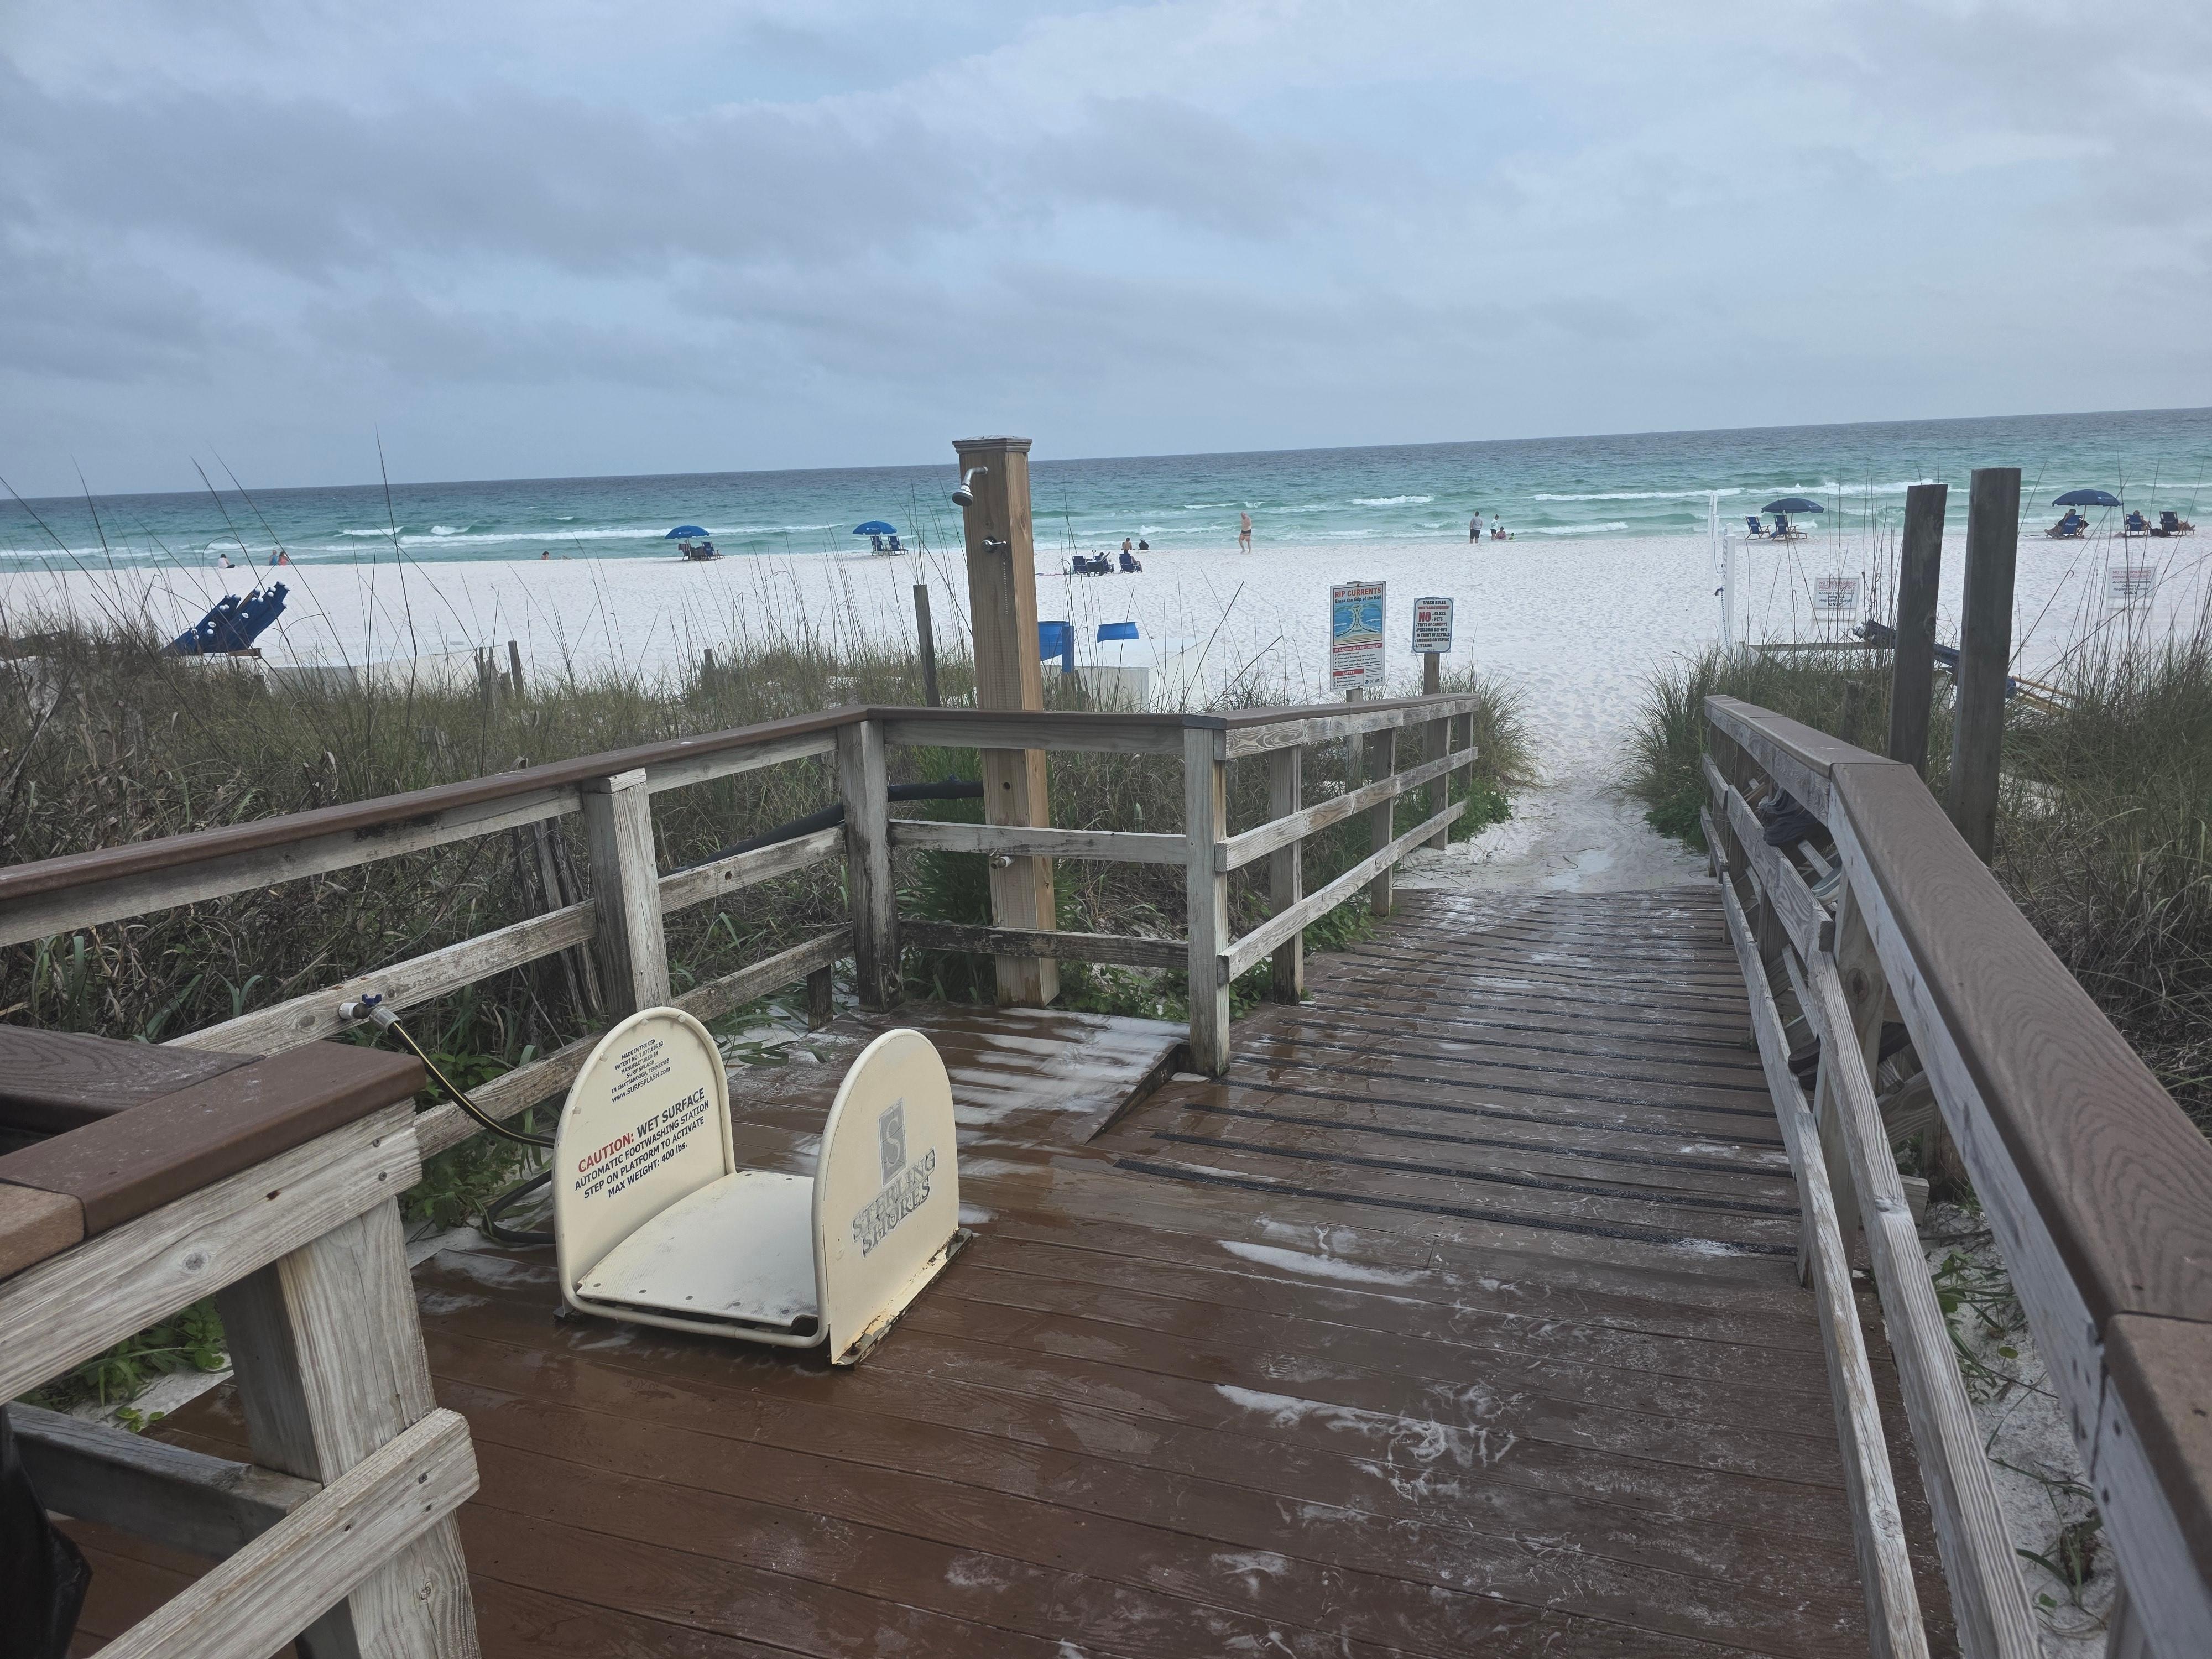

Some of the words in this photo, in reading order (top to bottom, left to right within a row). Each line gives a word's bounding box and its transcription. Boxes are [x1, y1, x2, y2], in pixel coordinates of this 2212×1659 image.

[1348, 587, 1381, 596] CURRENTS
[1418, 612, 1431, 622] NO
[615, 1058, 630, 1070] PATENT
[621, 1054, 653, 1074] MANUFACTURED
[622, 1051, 633, 1060] MADE
[627, 1068, 638, 1078] SURF
[639, 1059, 655, 1072] SPLASH
[648, 1058, 669, 1073] TENNESSEE
[612, 1067, 671, 1103] www.SURFSPLASH.com
[575, 1154, 623, 1191] AUTOMATIC
[625, 1119, 679, 1160] FOOTWASHING
[681, 1100, 709, 1125] STATION
[578, 1133, 634, 1173] CAUTION:
[637, 1115, 659, 1138] WET
[662, 1087, 705, 1123] SURFACE
[883, 1117, 900, 1169] S
[585, 1180, 604, 1199] STEP
[607, 1171, 618, 1185] ON
[620, 1145, 659, 1176] PLATFORM
[661, 1138, 670, 1150] TO
[672, 1116, 704, 1144] ACTIVATE
[608, 1180, 625, 1198] MAX
[627, 1159, 660, 1185] WEIGHT:
[661, 1148, 674, 1162] 400
[676, 1142, 687, 1154] lbs.
[853, 1146, 936, 1243] STERLING
[862, 1177, 930, 1259] SHORES
